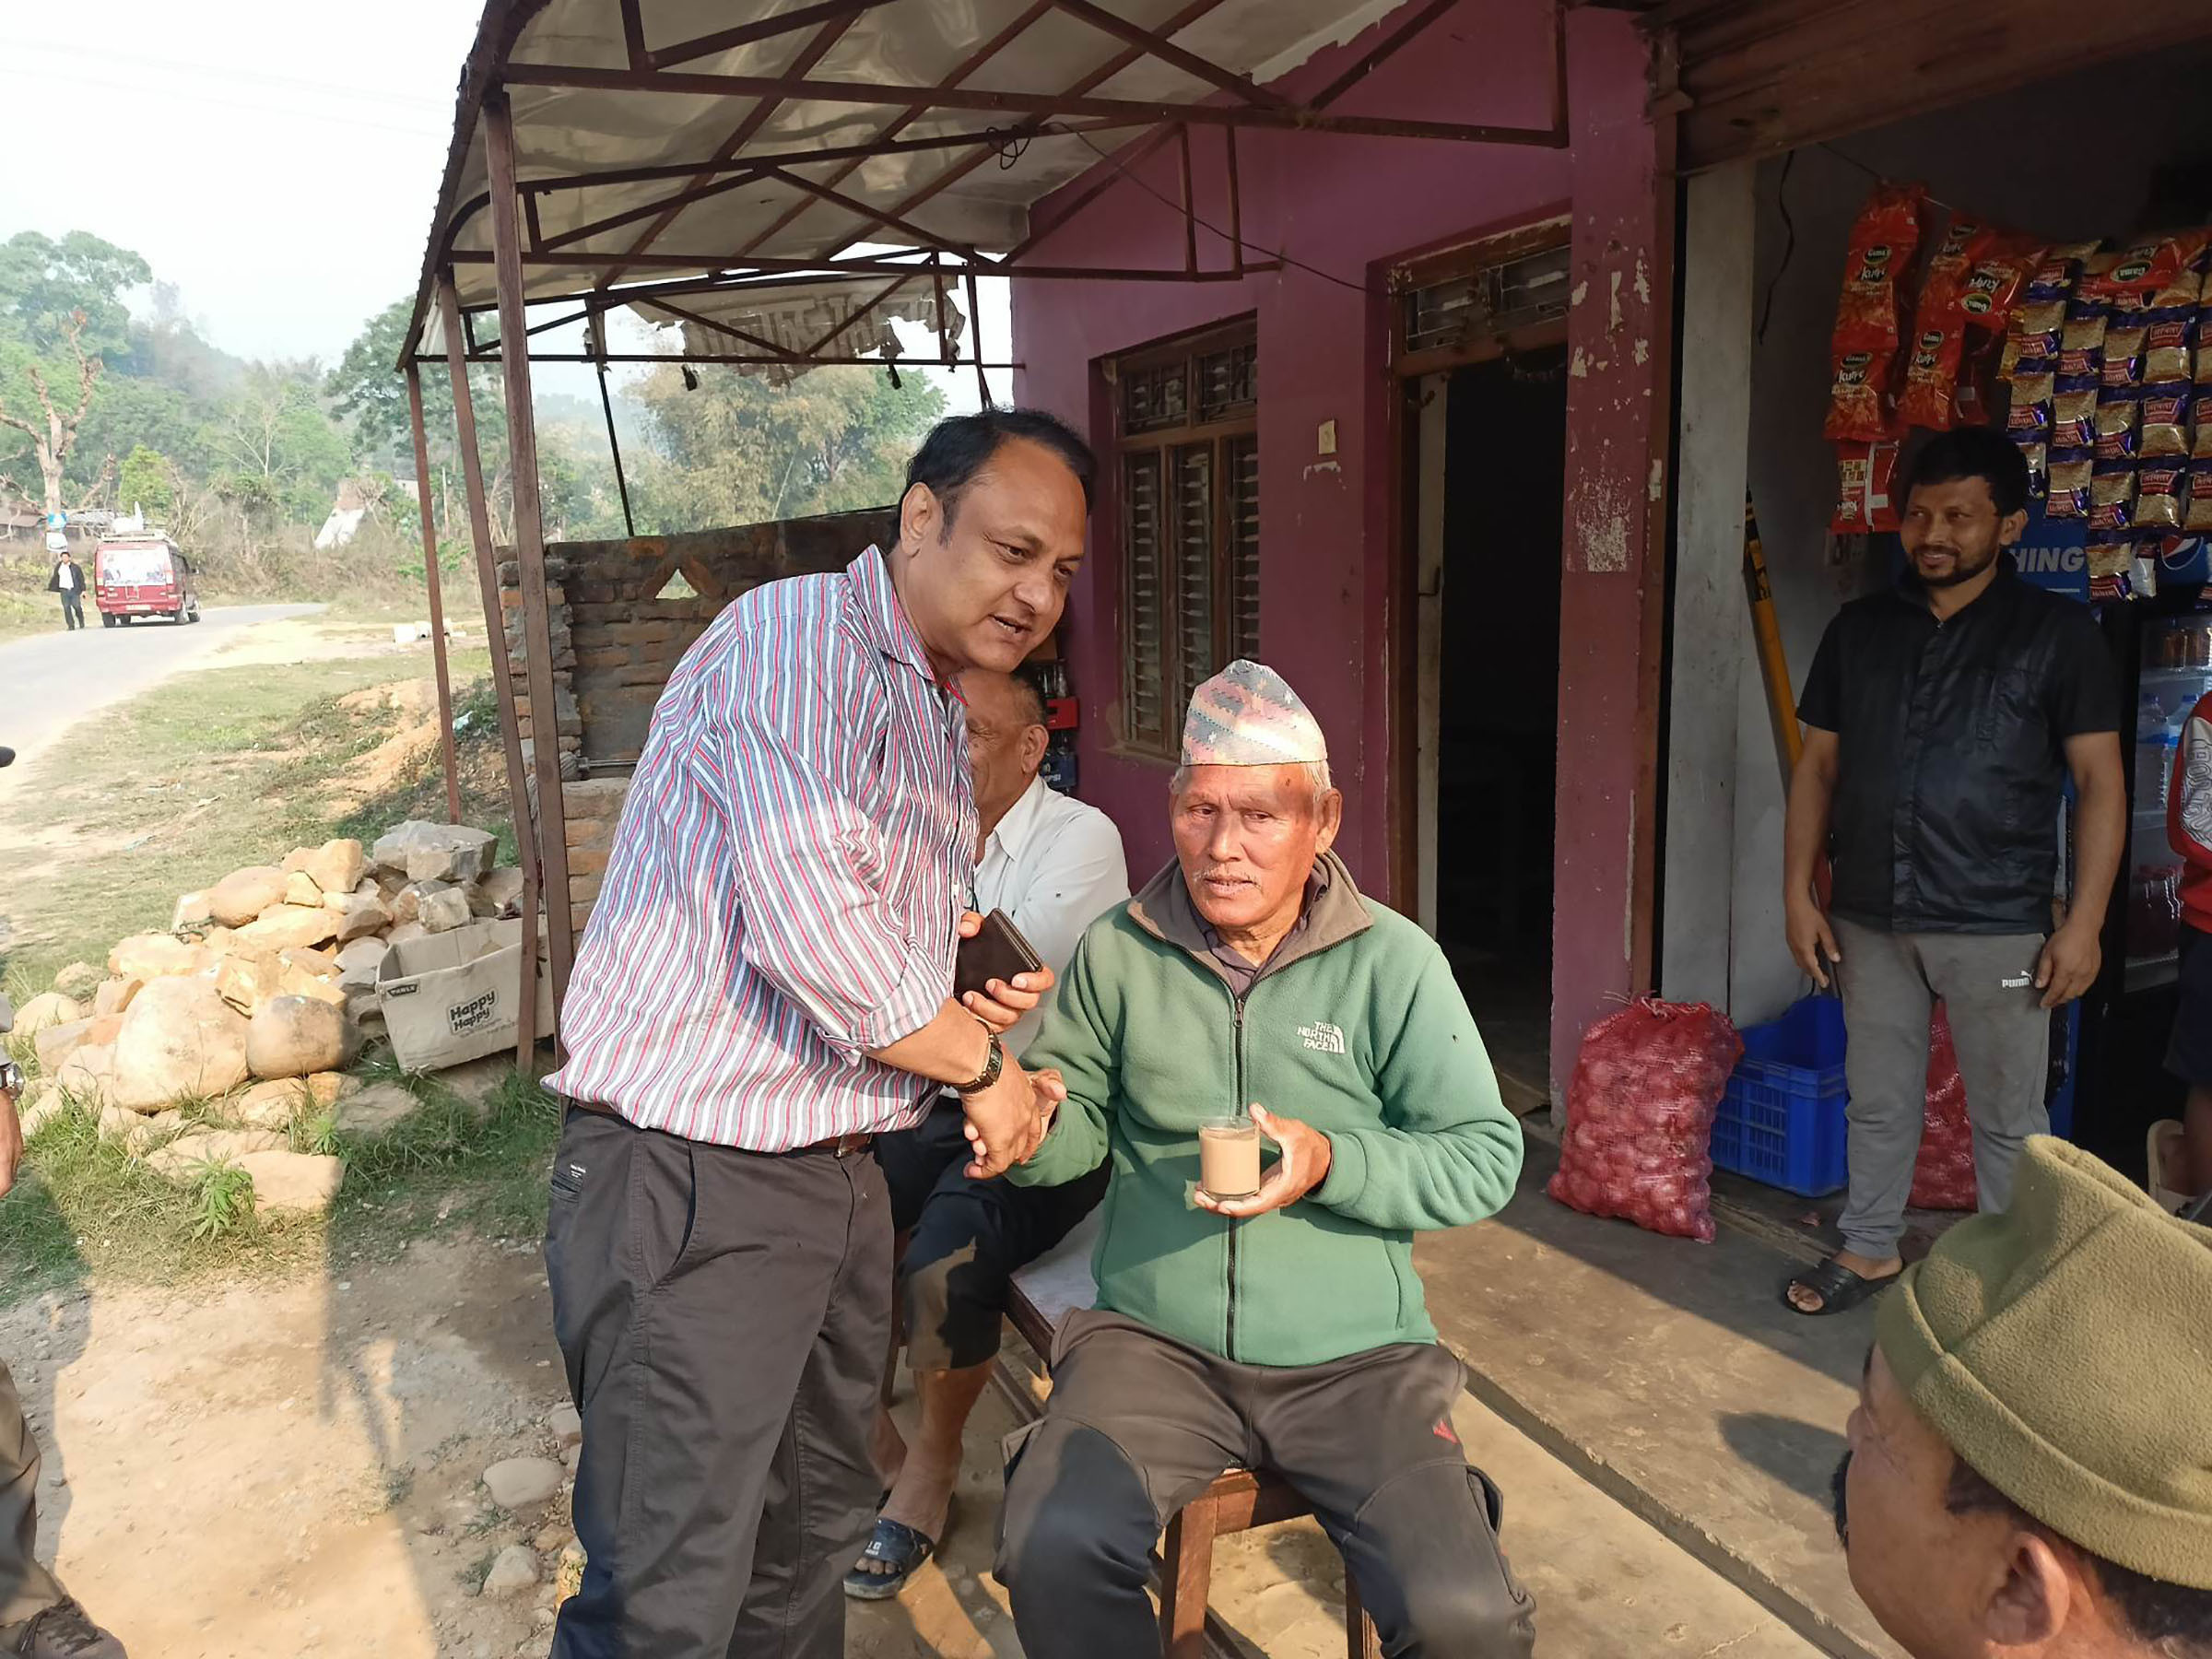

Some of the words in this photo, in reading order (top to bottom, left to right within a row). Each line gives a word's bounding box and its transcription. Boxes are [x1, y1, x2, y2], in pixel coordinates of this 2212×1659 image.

[449, 990, 496, 1021] Happy
[453, 1007, 491, 1031] Happy
[1314, 1020, 1333, 1032] THE
[1297, 1026, 1331, 1042] NORTH
[1303, 1038, 1329, 1052] FACE
